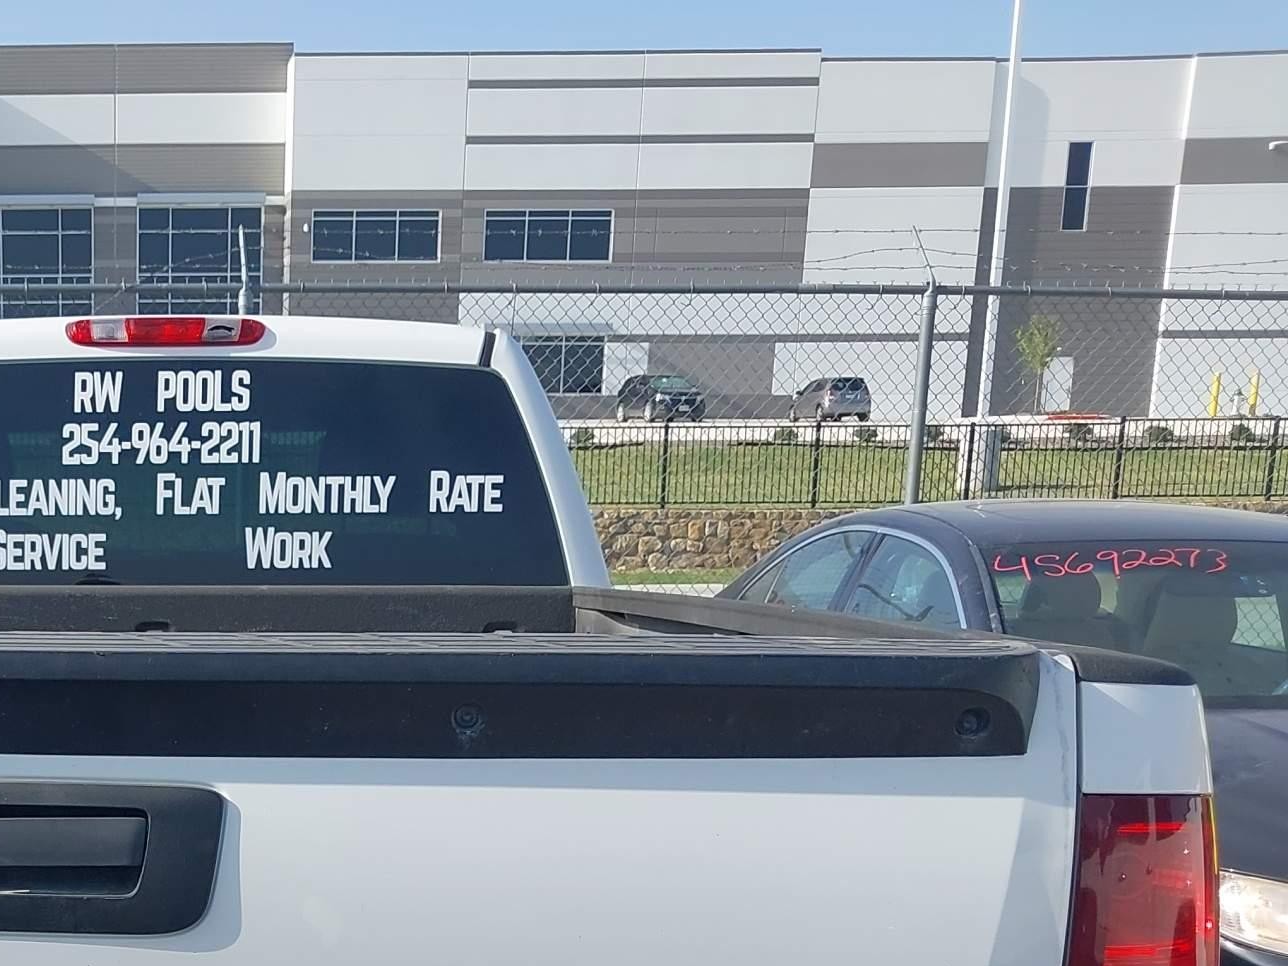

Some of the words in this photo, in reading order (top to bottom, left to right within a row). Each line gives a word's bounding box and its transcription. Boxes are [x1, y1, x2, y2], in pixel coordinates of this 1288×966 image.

[73, 370, 124, 413] RW
[157, 369, 251, 413] POOLS
[61, 420, 261, 466] 254-964-2211
[994, 548, 1228, 581] 45692273
